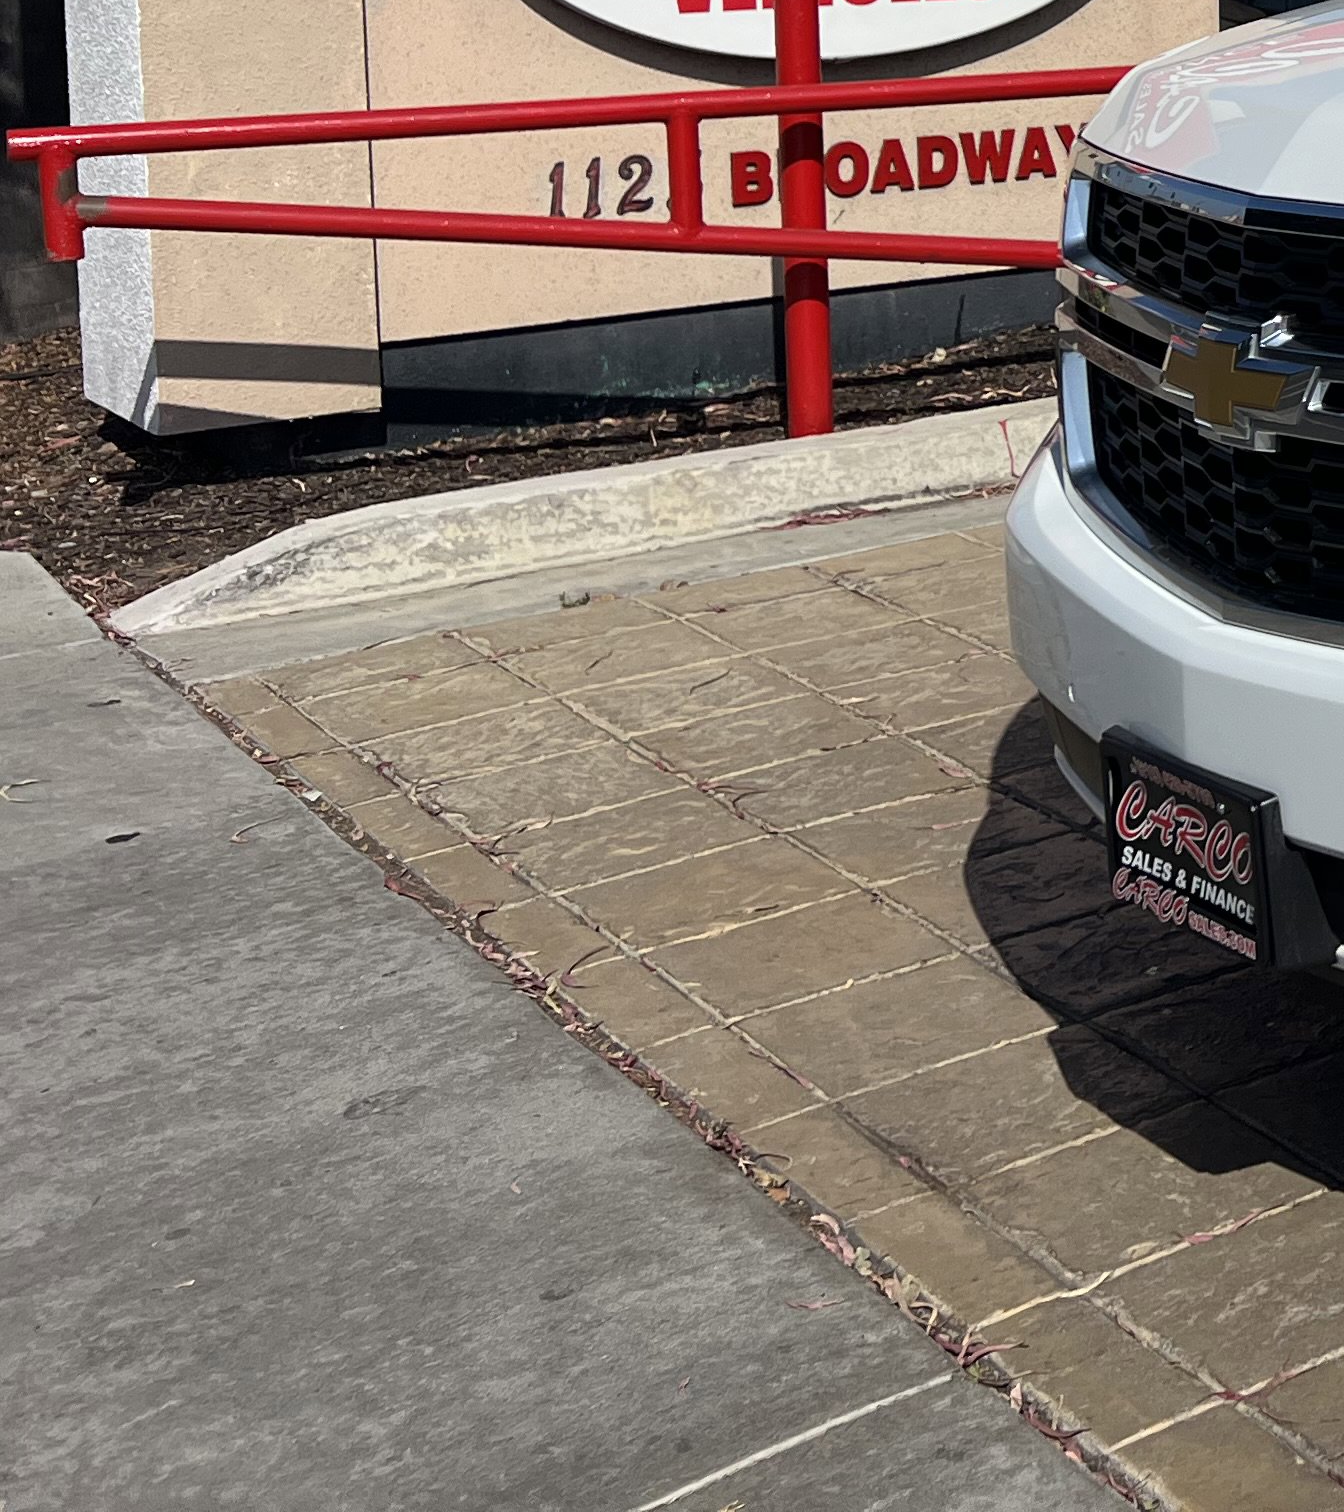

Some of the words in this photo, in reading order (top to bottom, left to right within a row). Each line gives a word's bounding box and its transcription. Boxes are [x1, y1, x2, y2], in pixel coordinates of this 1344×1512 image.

[549, 154, 703, 219] 112
[730, 121, 1086, 209] BOADWA
[1116, 779, 1253, 885] CARCO
[1121, 846, 1173, 882] SALES
[1175, 869, 1187, 889] &
[1191, 875, 1256, 925] FINANCE
